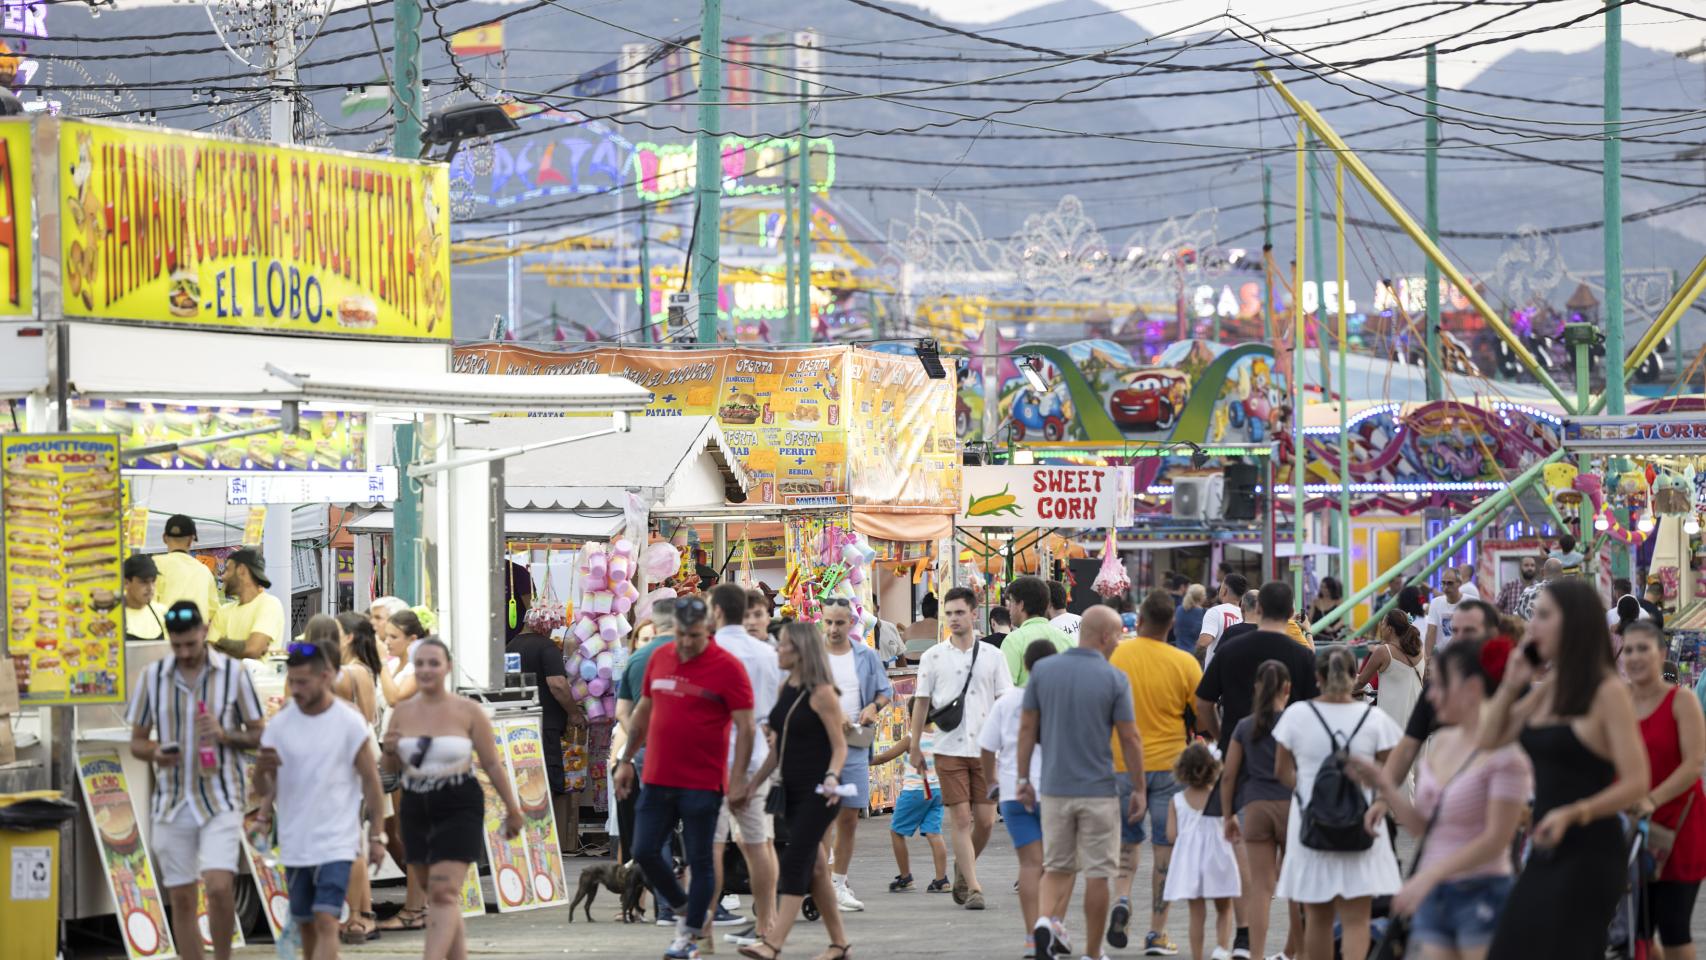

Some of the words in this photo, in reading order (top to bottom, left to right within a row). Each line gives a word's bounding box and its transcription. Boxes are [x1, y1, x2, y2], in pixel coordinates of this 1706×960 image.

[735, 359, 773, 374] OFERTA
[797, 359, 830, 374] OFERTA
[645, 408, 683, 417] PATATAS
[784, 430, 824, 447] OFERTA
[779, 447, 816, 456] PERRIT
[788, 468, 813, 476] BEBIDA
[1033, 469, 1105, 493] SWEET
[1037, 496, 1098, 520] CORN
